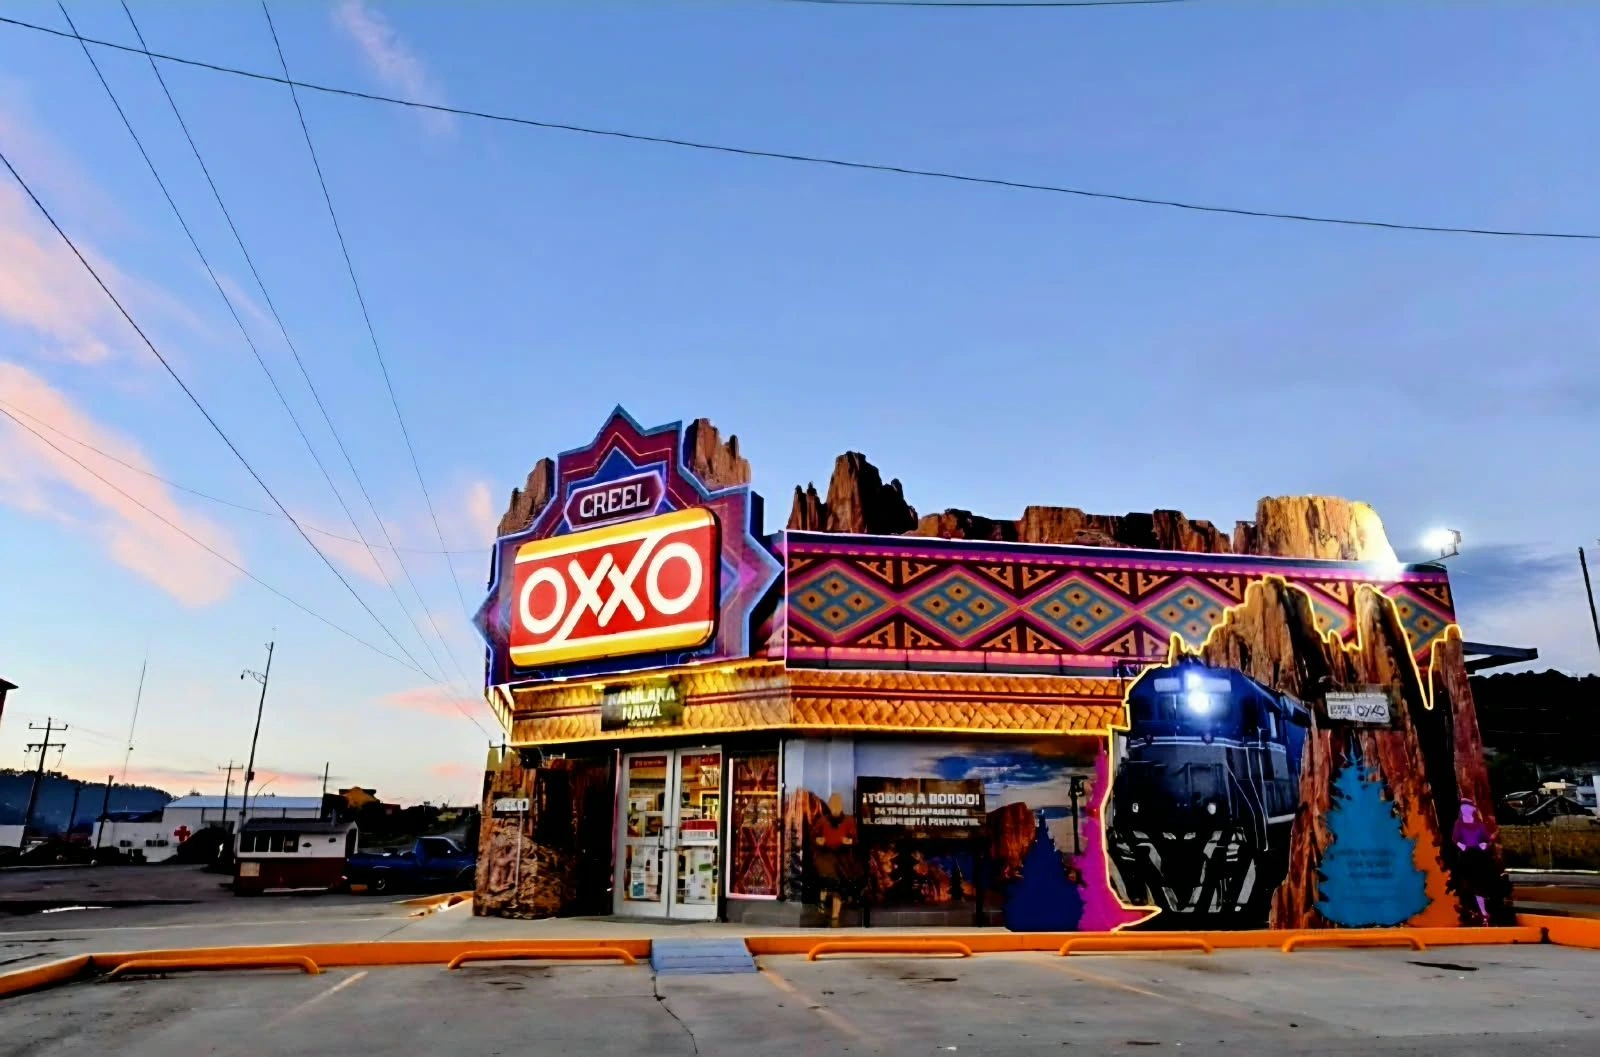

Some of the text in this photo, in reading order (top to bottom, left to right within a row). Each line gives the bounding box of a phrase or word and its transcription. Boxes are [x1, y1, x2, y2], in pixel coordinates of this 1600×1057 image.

[580, 483, 650, 518] CREEL
[519, 538, 703, 643] OXXO
[917, 793, 926, 805] A
